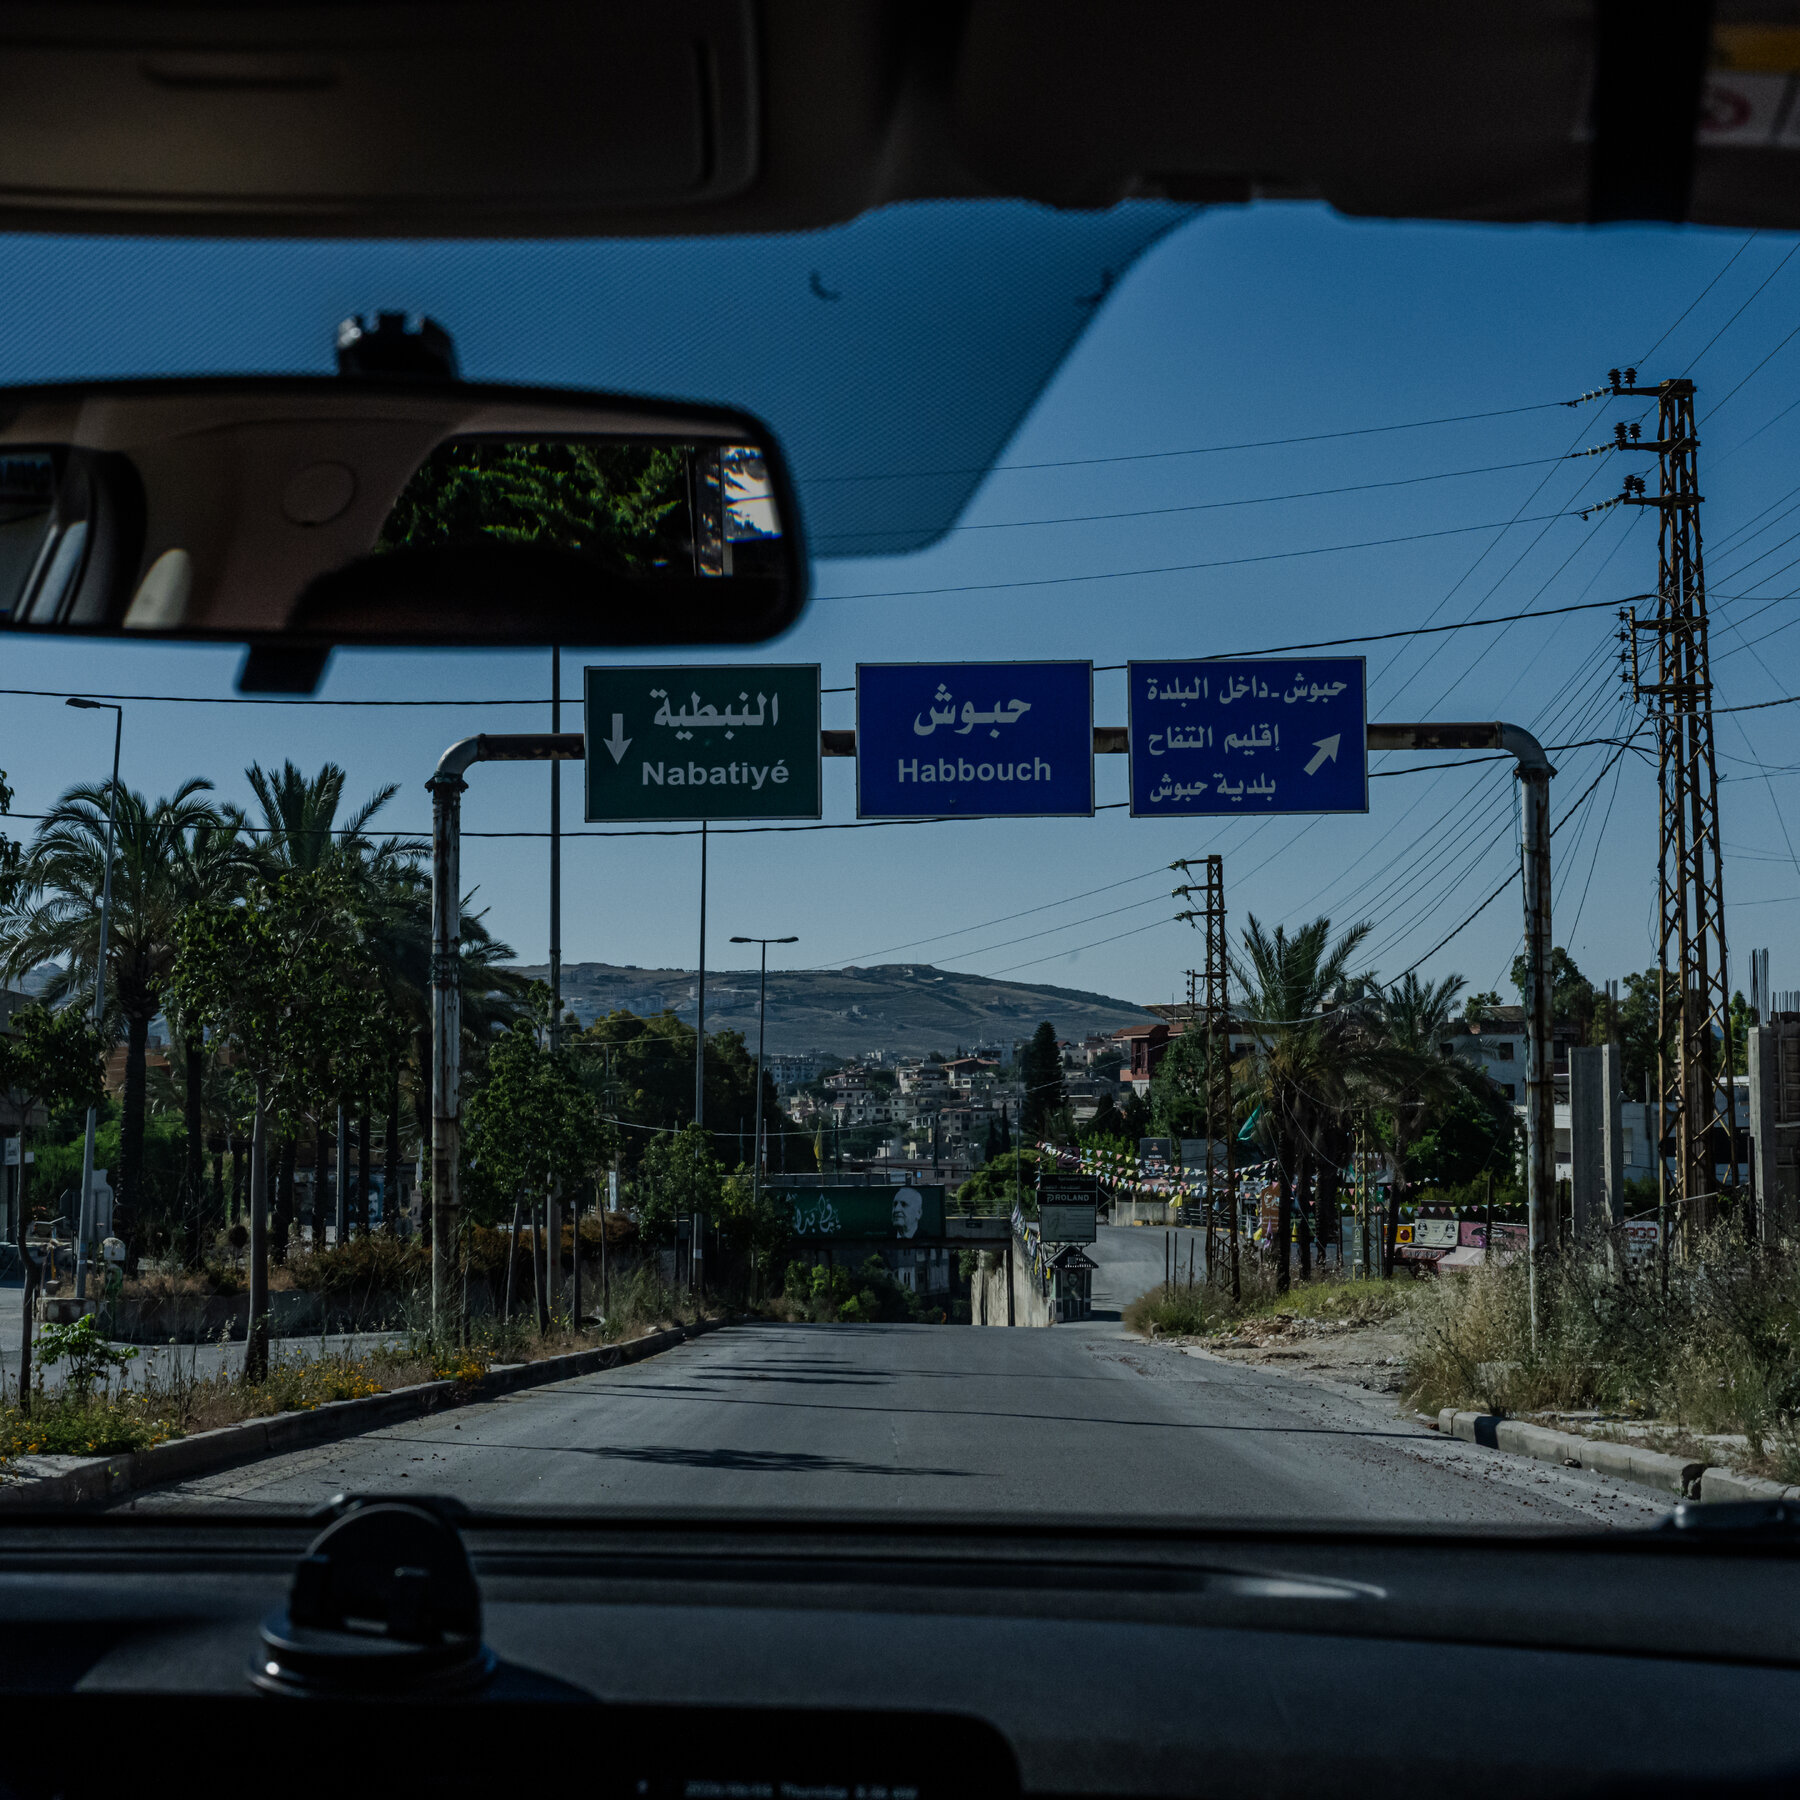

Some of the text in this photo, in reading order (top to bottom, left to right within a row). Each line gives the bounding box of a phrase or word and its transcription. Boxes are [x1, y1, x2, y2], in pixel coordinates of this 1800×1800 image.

[1146, 675, 1209, 708] البلدة
[649, 687, 780, 741] النبطية
[913, 683, 1032, 739] حبوش
[1148, 722, 1280, 756] إقليم التفاح
[642, 759, 789, 791] Nabatiyé
[898, 756, 1051, 783] Habbouch
[1149, 771, 1277, 803] بلدية حبوش
